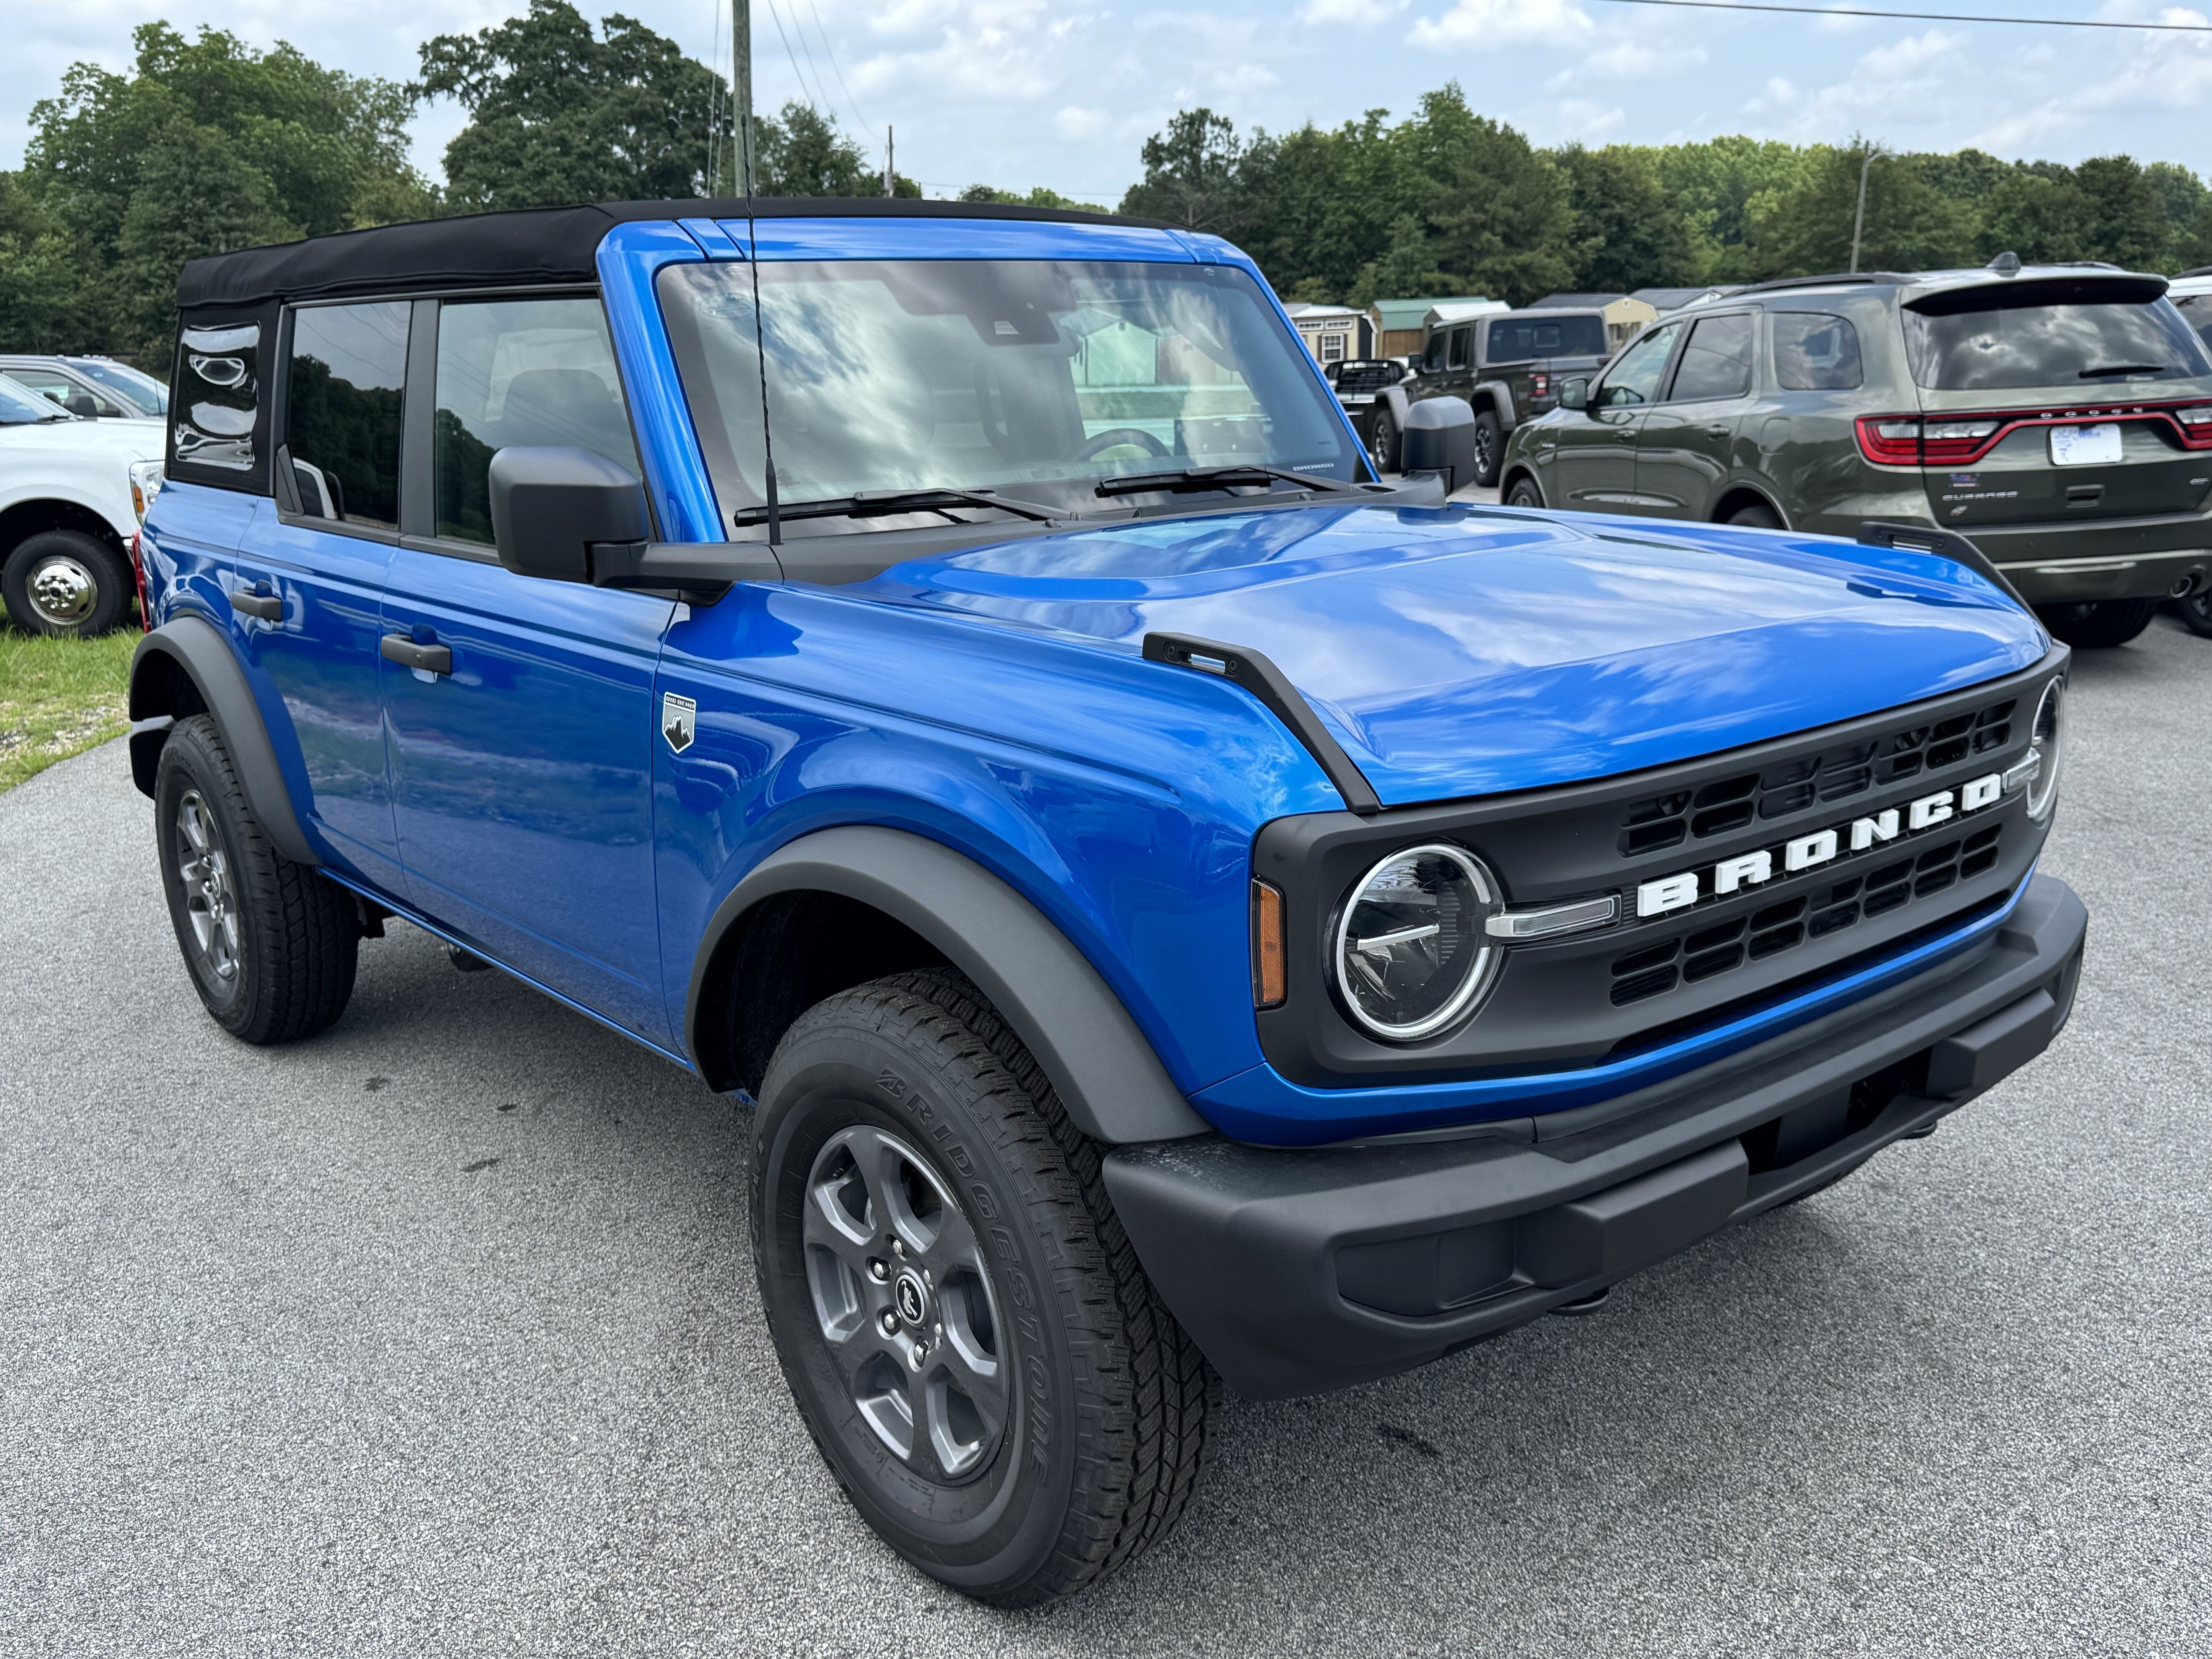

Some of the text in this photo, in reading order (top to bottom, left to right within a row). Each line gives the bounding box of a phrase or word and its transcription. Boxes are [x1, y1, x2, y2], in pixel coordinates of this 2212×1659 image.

[1293, 463, 1334, 471] BRONCO
[1637, 773, 2001, 917] BRONCO
[874, 1069, 1056, 1485] BRIDGESTONE
